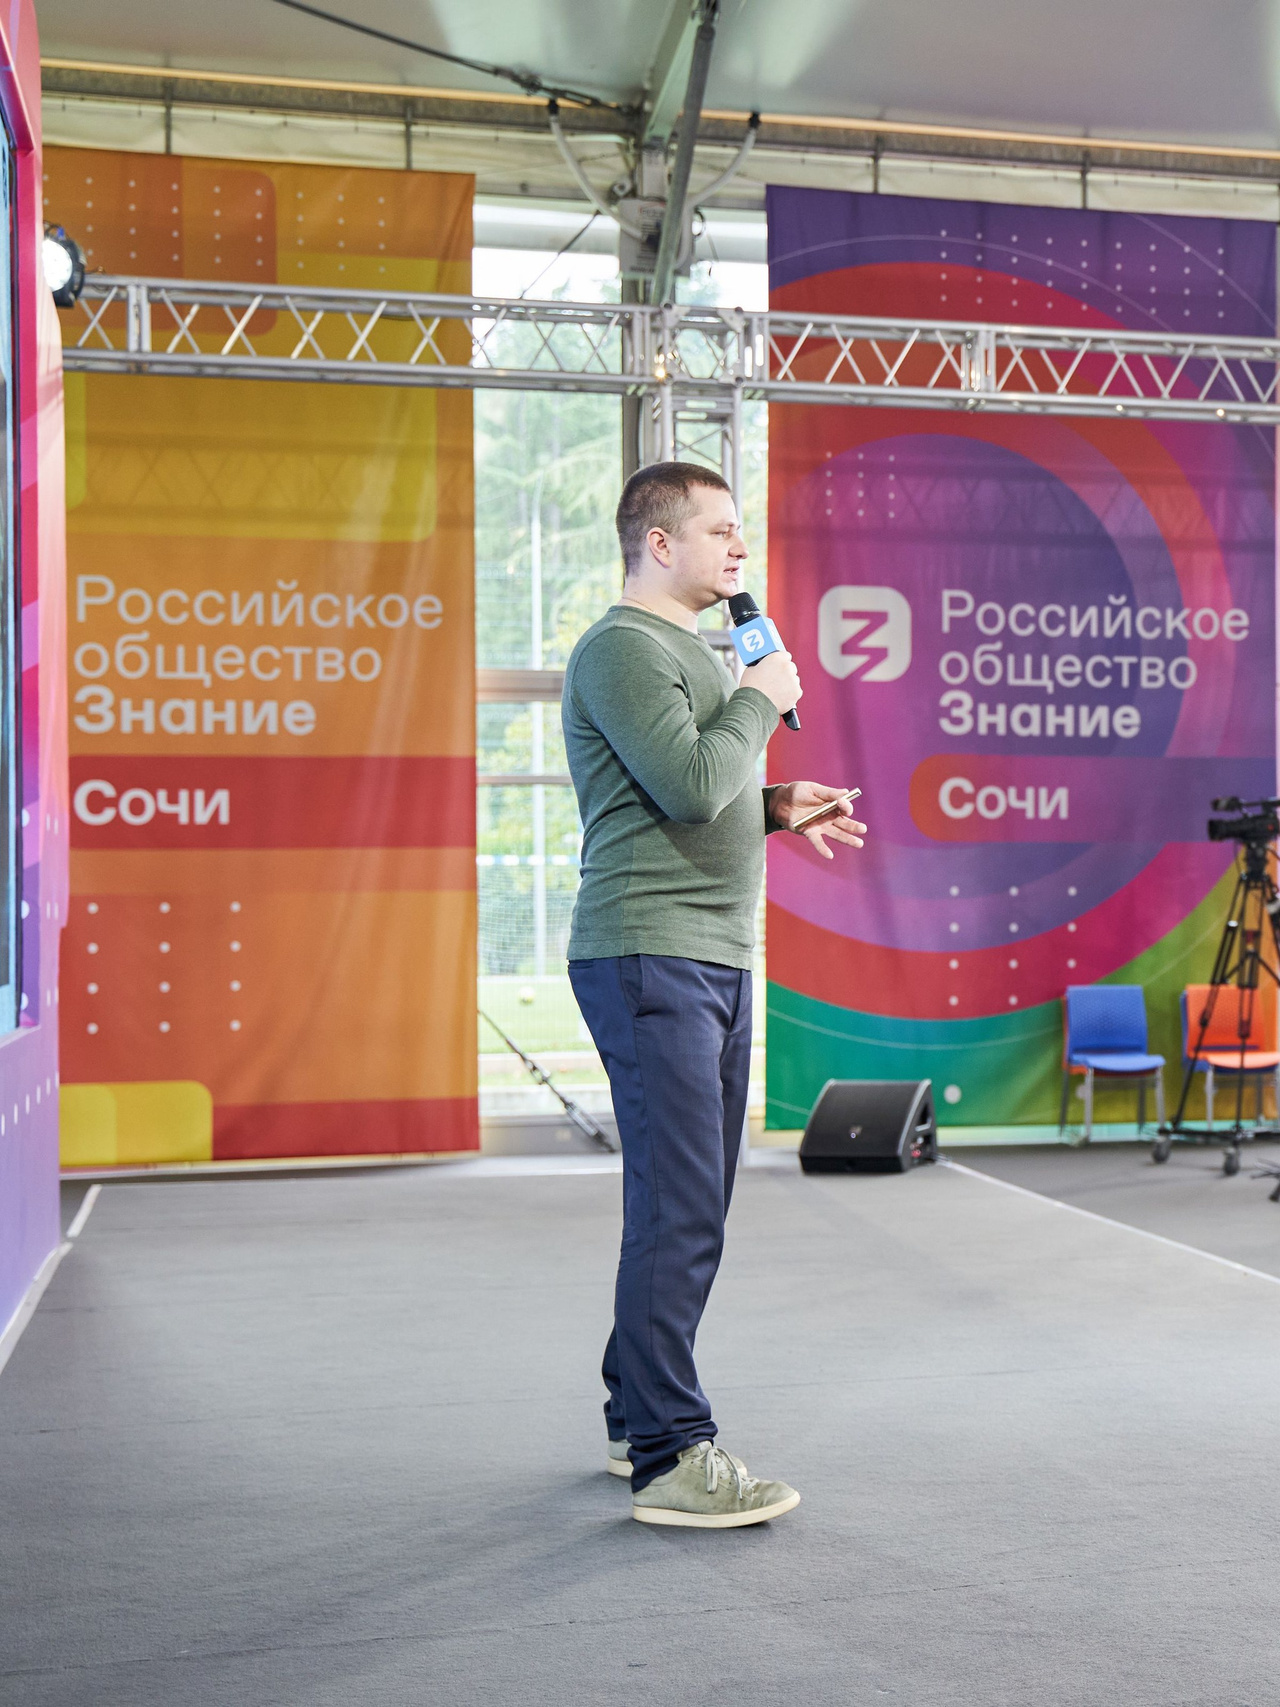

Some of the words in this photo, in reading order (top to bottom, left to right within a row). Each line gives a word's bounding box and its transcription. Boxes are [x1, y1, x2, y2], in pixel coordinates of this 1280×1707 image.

[77, 573, 443, 629] Российское
[941, 588, 1250, 641] Российское
[74, 631, 382, 687] общество
[940, 642, 1197, 693] общество
[74, 685, 316, 735] Знание
[939, 690, 1141, 738] Знание
[74, 779, 230, 825] Сочи
[939, 777, 1069, 820] Сочи
